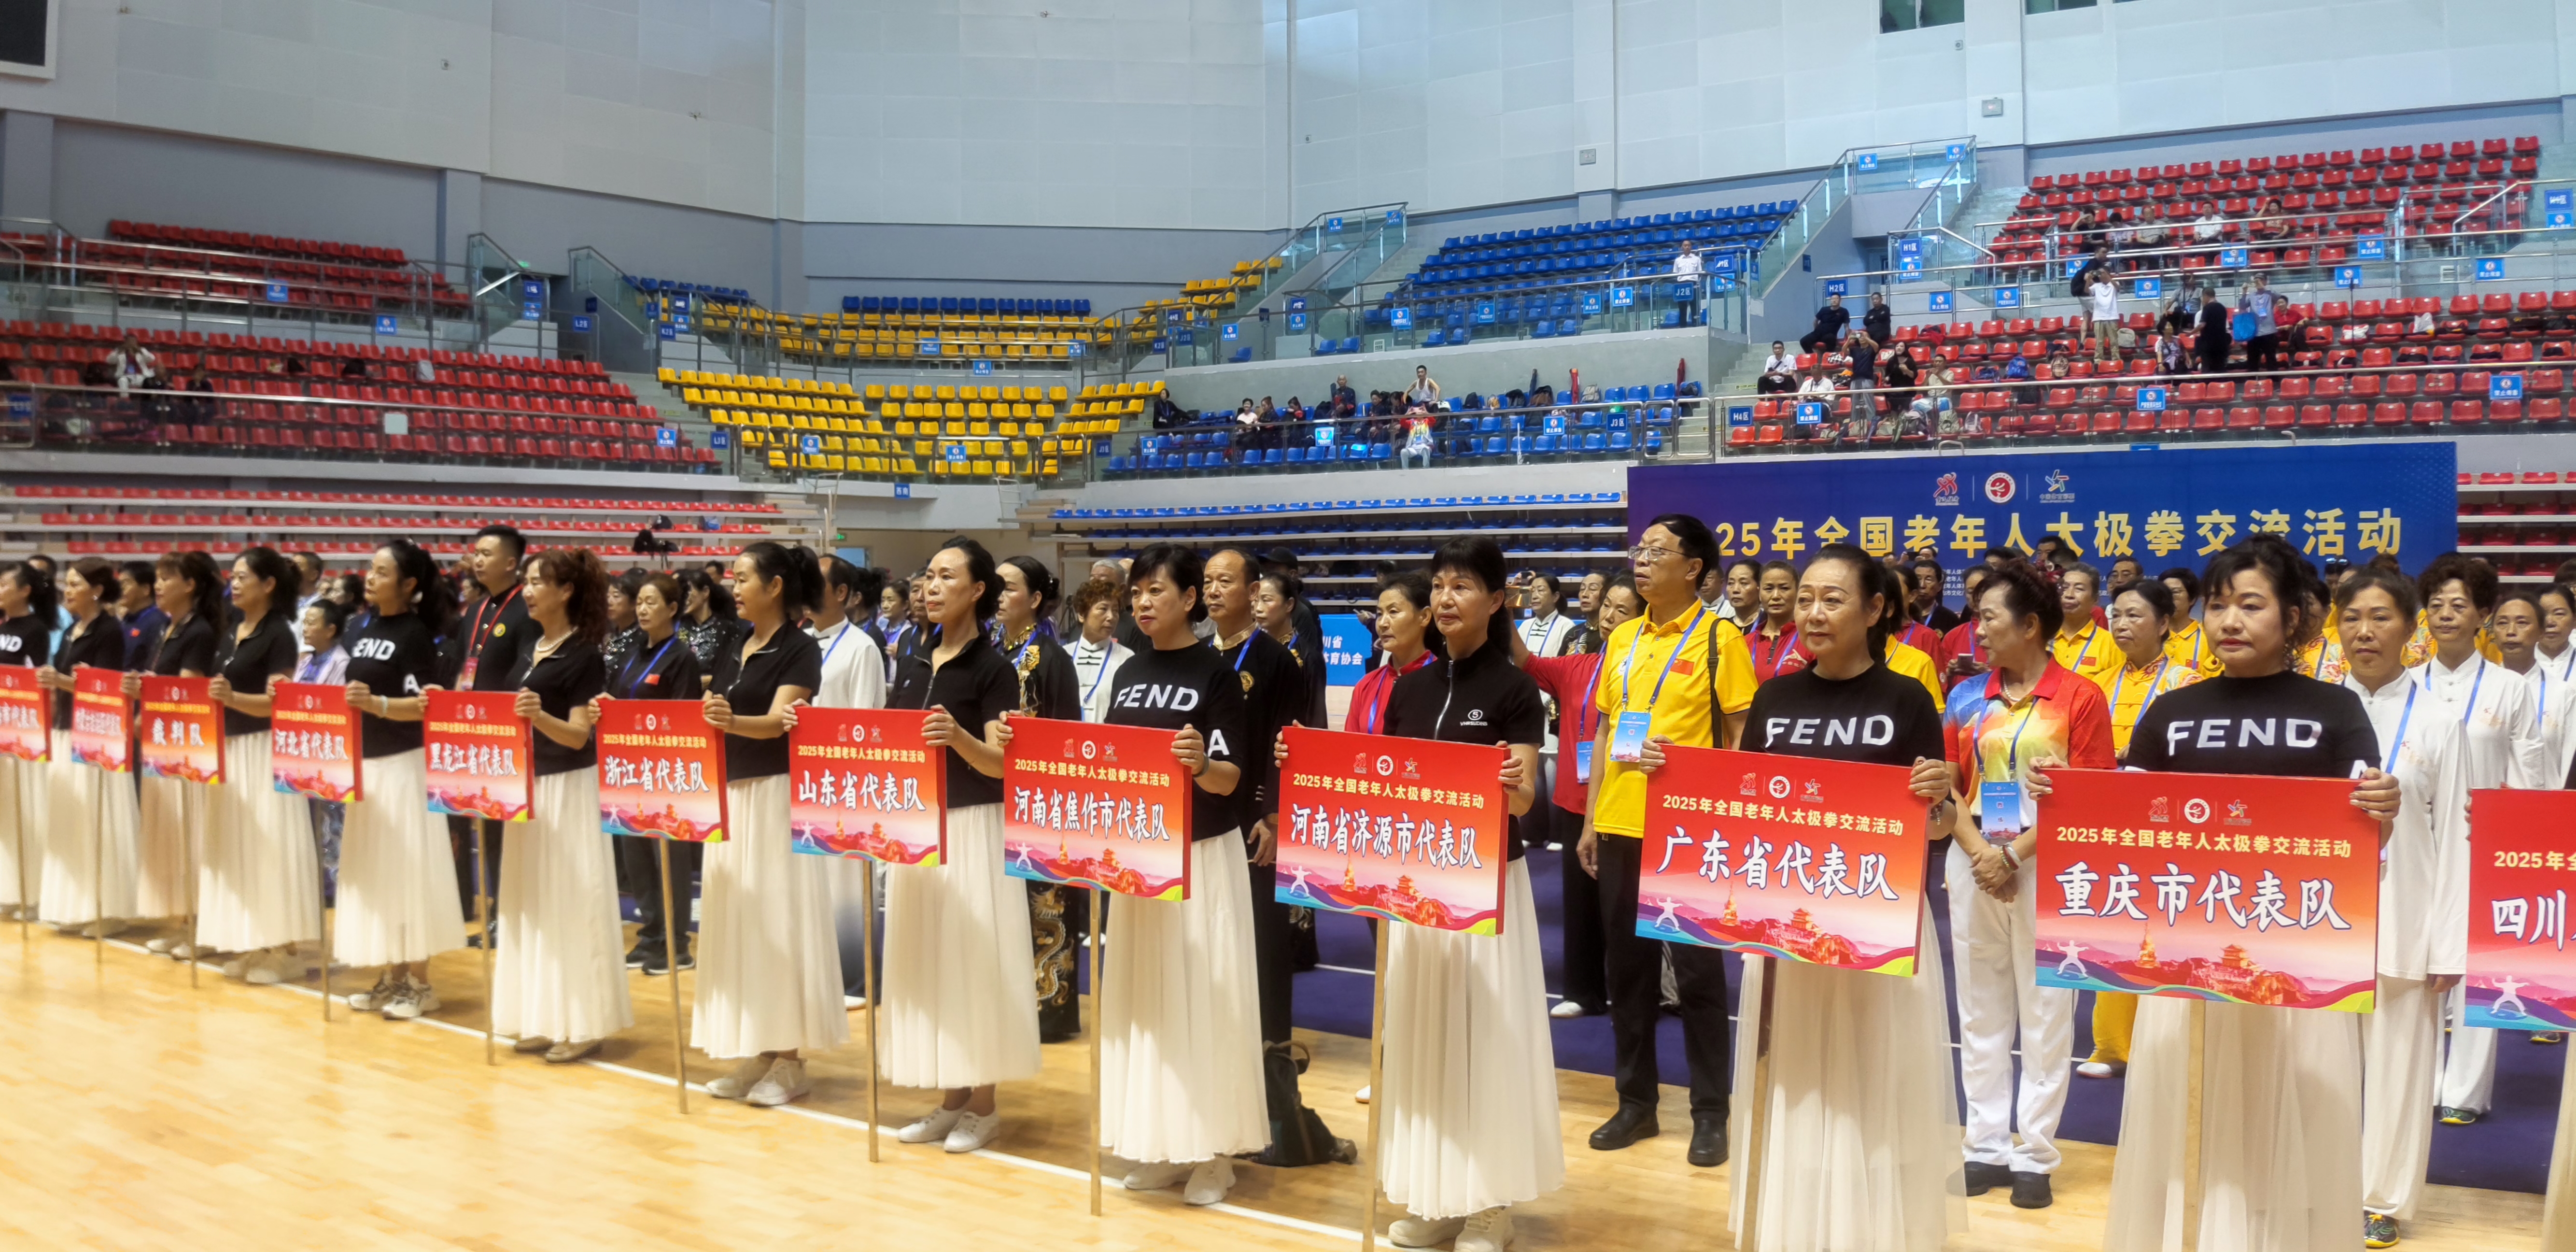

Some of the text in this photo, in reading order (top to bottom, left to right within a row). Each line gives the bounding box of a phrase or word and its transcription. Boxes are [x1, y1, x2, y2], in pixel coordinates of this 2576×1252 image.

[1829, 284, 1844, 292] H2区
[1610, 419, 1625, 427] J3区
[1733, 412, 1749, 421] H4区
[1113, 683, 1199, 711] FEND
[152, 717, 206, 747] 裁判队
[274, 727, 349, 761] 河北省代表队
[1207, 728, 1230, 757] A
[1765, 714, 1895, 748] FEND
[2167, 718, 2323, 756] FEND
[429, 742, 518, 777] 黑龙江省代表队
[798, 745, 926, 764] 2025年全国老年人太极拳交流活动
[604, 754, 710, 795] 浙江省代表队
[1015, 758, 1170, 787] 2025年全国老年人太极拳交流活动
[798, 768, 927, 813] 山东省代表队
[1293, 773, 1484, 810] 2025年全国老年人太极拳交流活动
[1014, 785, 1170, 842] 河南省焦作市代表队
[1662, 794, 1903, 836] 2025年全国老年人太极拳交流活动
[1291, 803, 1482, 870] 河南省济源市代表队
[2056, 826, 2351, 858] 2025年全国老年人太极拳交流活动
[1656, 825, 1900, 901] 广东省代表队
[2055, 861, 2352, 933] 重庆市代表队
[2491, 889, 2576, 952] 四川
